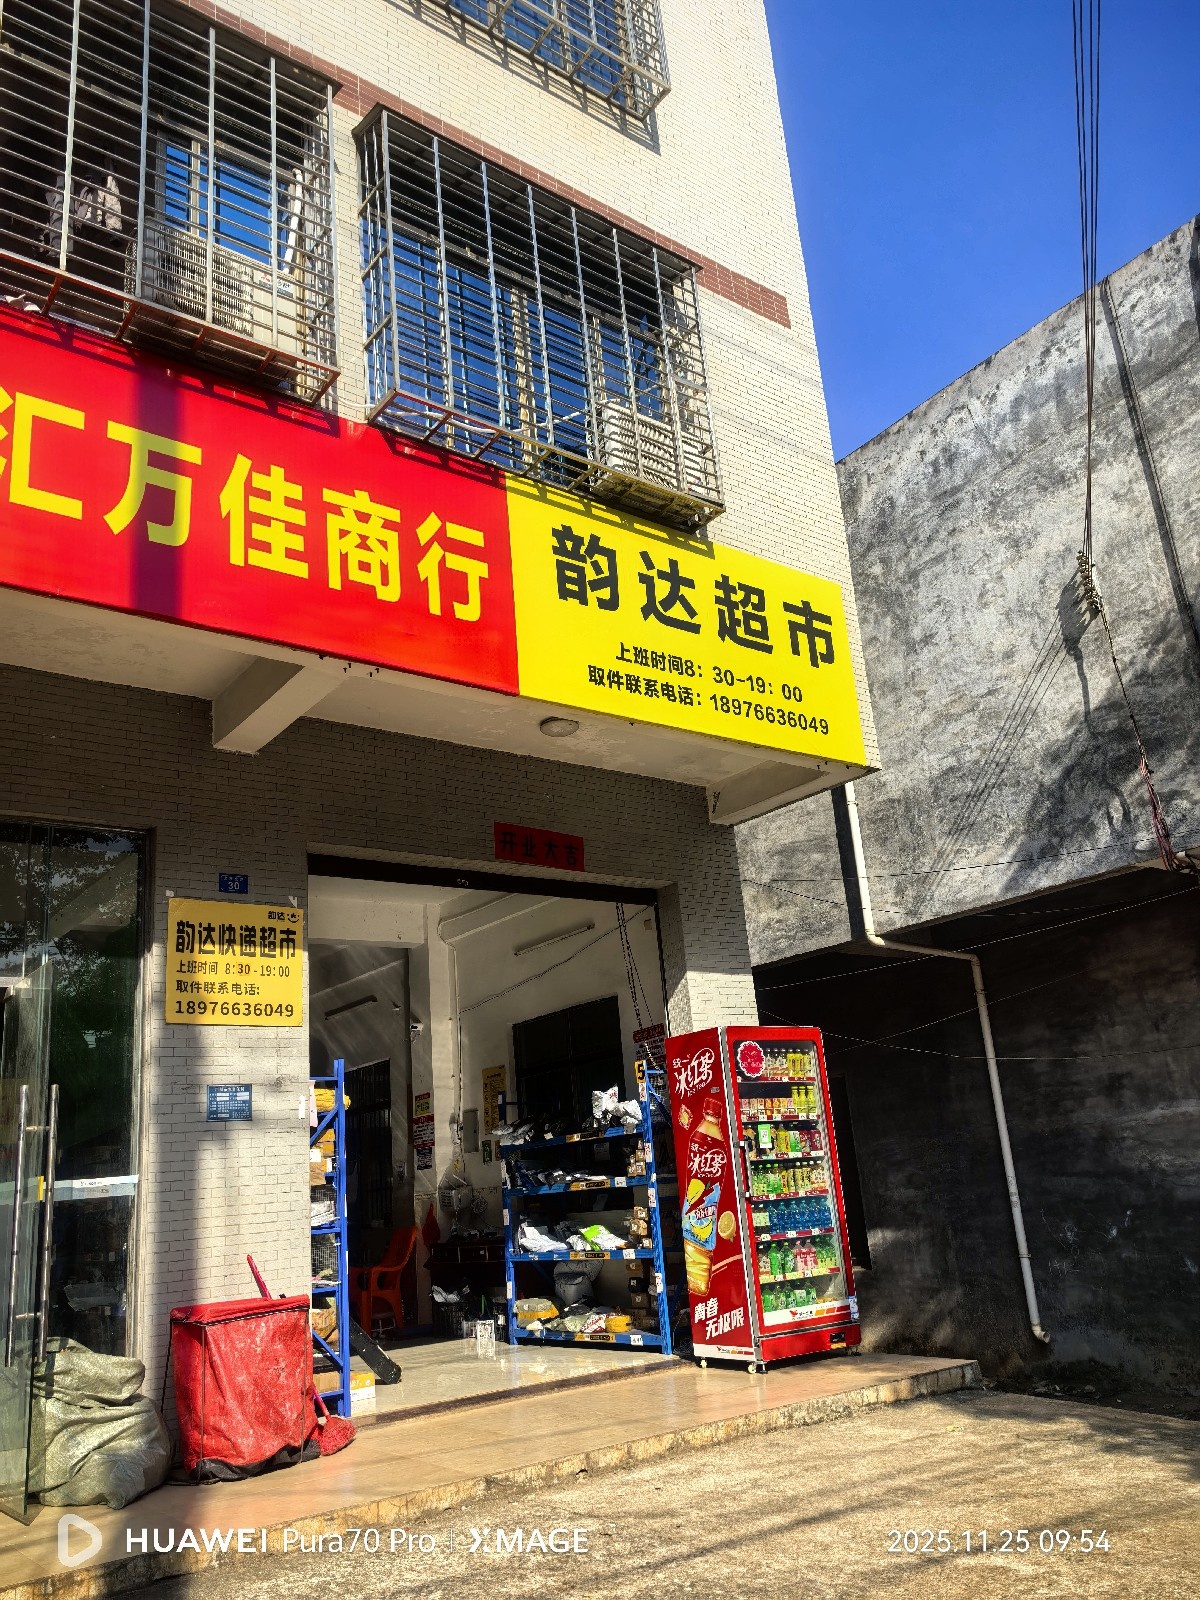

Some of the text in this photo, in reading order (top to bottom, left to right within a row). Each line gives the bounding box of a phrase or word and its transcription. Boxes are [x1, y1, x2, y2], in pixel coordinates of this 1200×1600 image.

[551, 523, 836, 668] 韵达超市
[499, 831, 579, 867] 开业大吉
[228, 881, 240, 890] 30
[175, 919, 297, 959] 韵达快递超市
[176, 960, 218, 975] 上班时间
[175, 1000, 294, 1017] 18976636049
[673, 1047, 715, 1100] 冰红茶
[705, 1306, 744, 1341] 无极限
